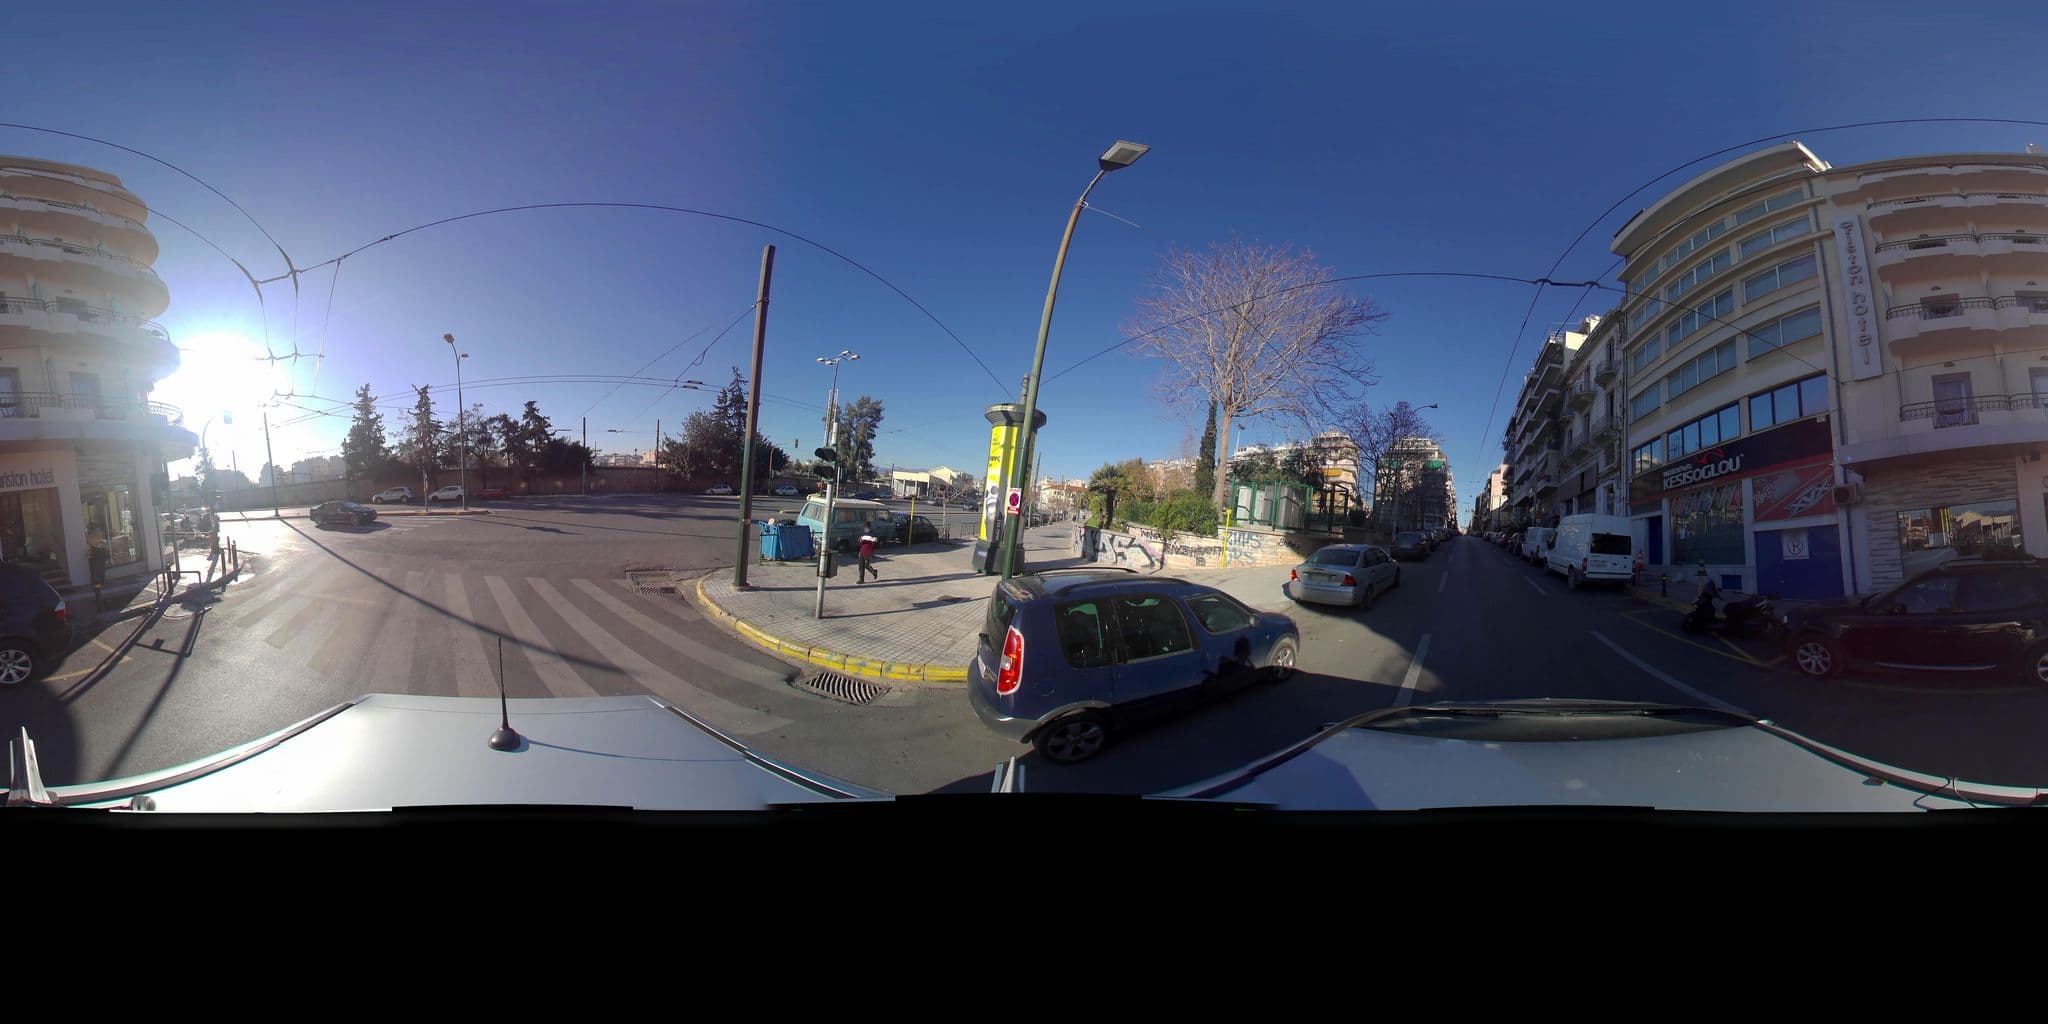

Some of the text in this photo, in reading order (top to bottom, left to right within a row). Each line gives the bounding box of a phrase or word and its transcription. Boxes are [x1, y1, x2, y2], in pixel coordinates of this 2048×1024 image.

[1853, 293, 1872, 365] hotel
[29, 467, 55, 486] hotel
[1663, 456, 1740, 489] KESISOGLOU
